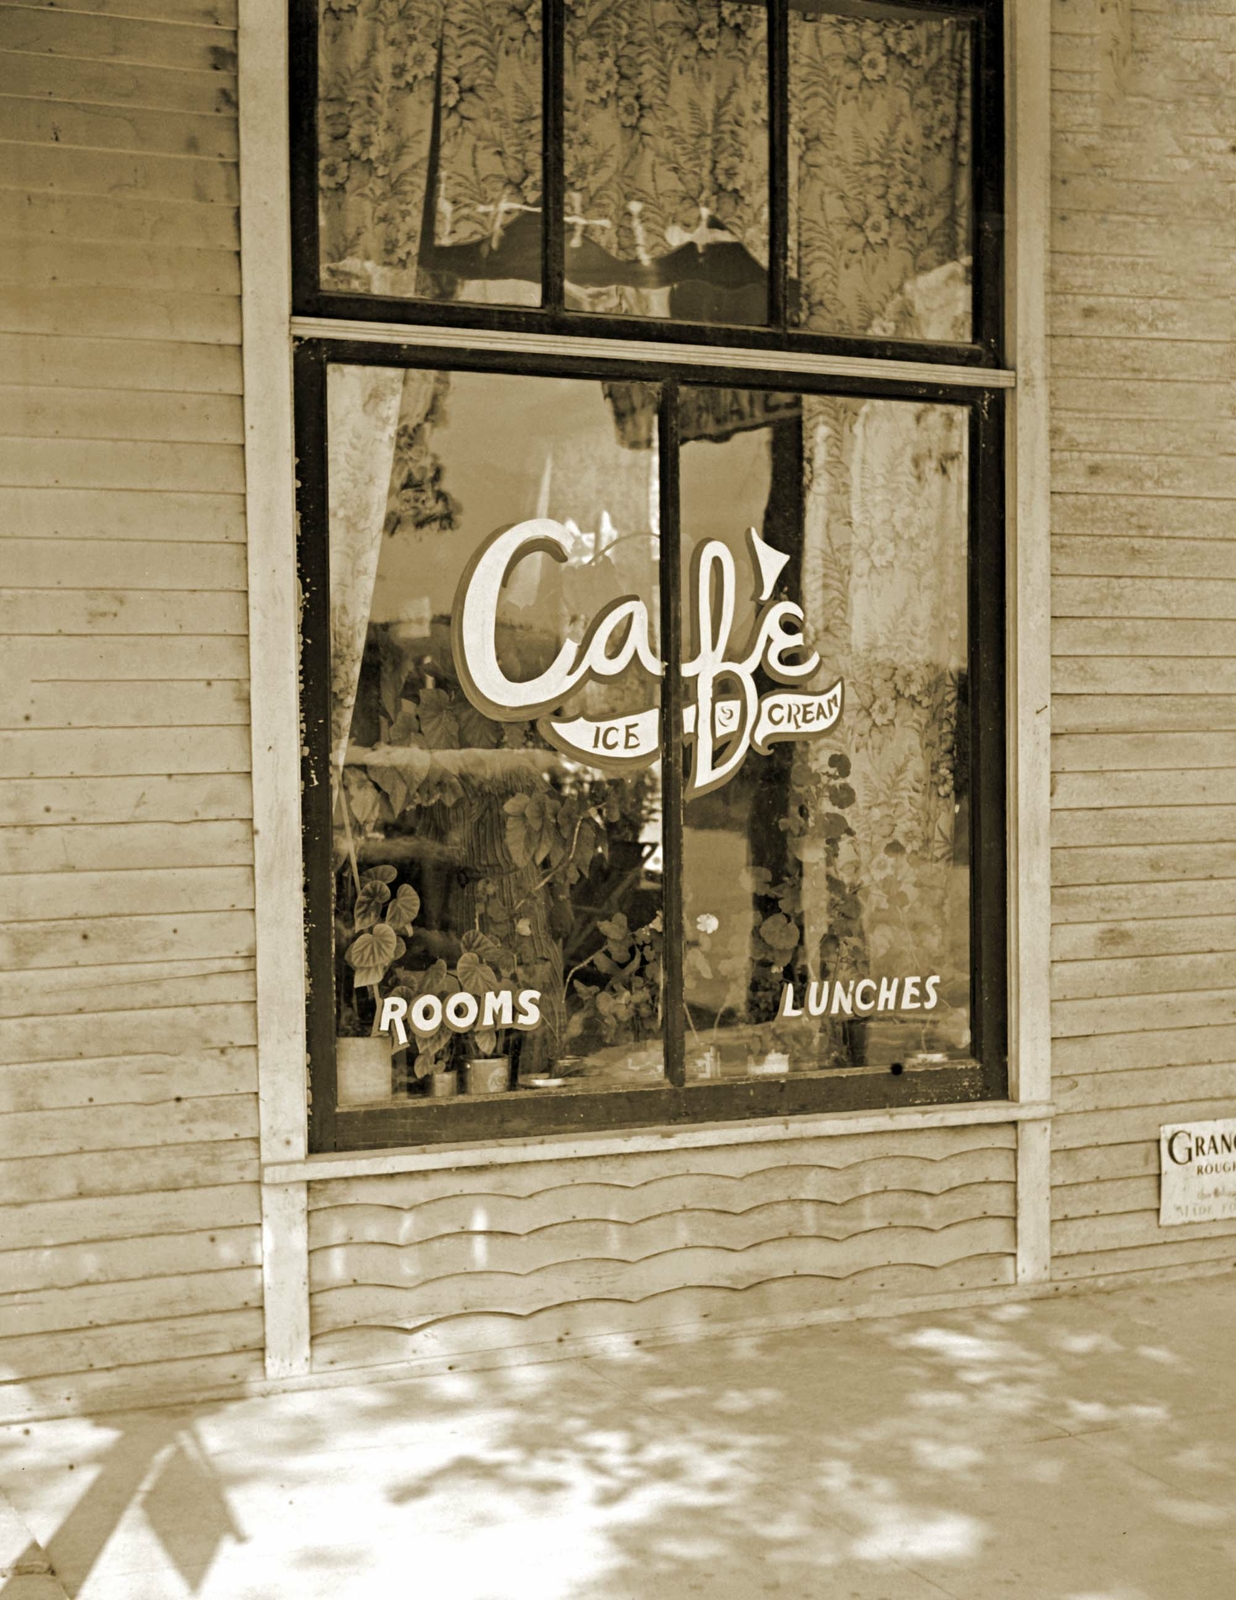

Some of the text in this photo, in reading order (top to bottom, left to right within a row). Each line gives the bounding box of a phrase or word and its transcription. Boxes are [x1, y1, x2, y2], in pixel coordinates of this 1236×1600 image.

[593, 693, 839, 751] ICE CREAM
[378, 989, 542, 1045] ROOMS
[781, 975, 941, 1018] LUNCHES
[1167, 1130, 1236, 1166] GRAN
